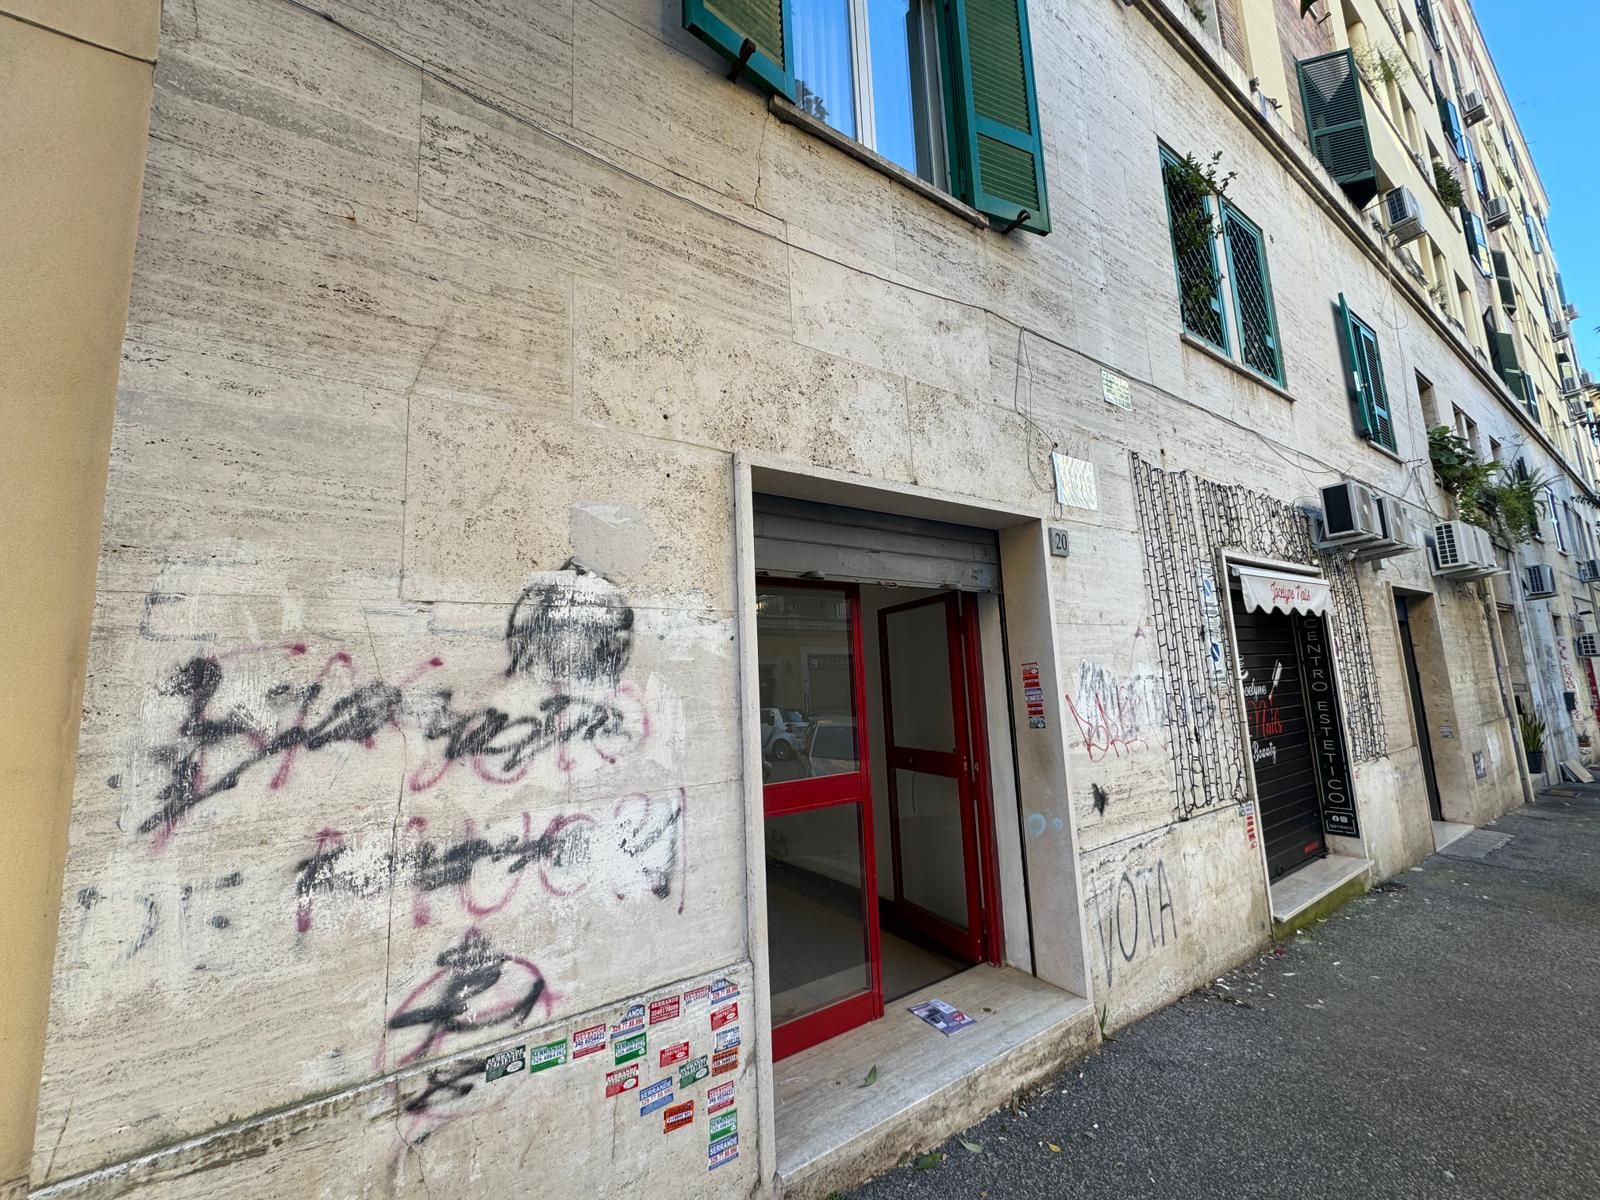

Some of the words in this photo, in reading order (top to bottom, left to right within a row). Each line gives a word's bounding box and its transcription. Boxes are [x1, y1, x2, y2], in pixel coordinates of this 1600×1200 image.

[1055, 533, 1067, 550] 20
[1304, 619, 1328, 692] CENTRO
[1245, 678, 1267, 702] ocelyne
[1318, 701, 1345, 803] ESTETICO
[1091, 860, 1177, 988] VOTA
[640, 1081, 672, 1099] SERRANDE
[710, 1137, 738, 1156] SERRANDE
